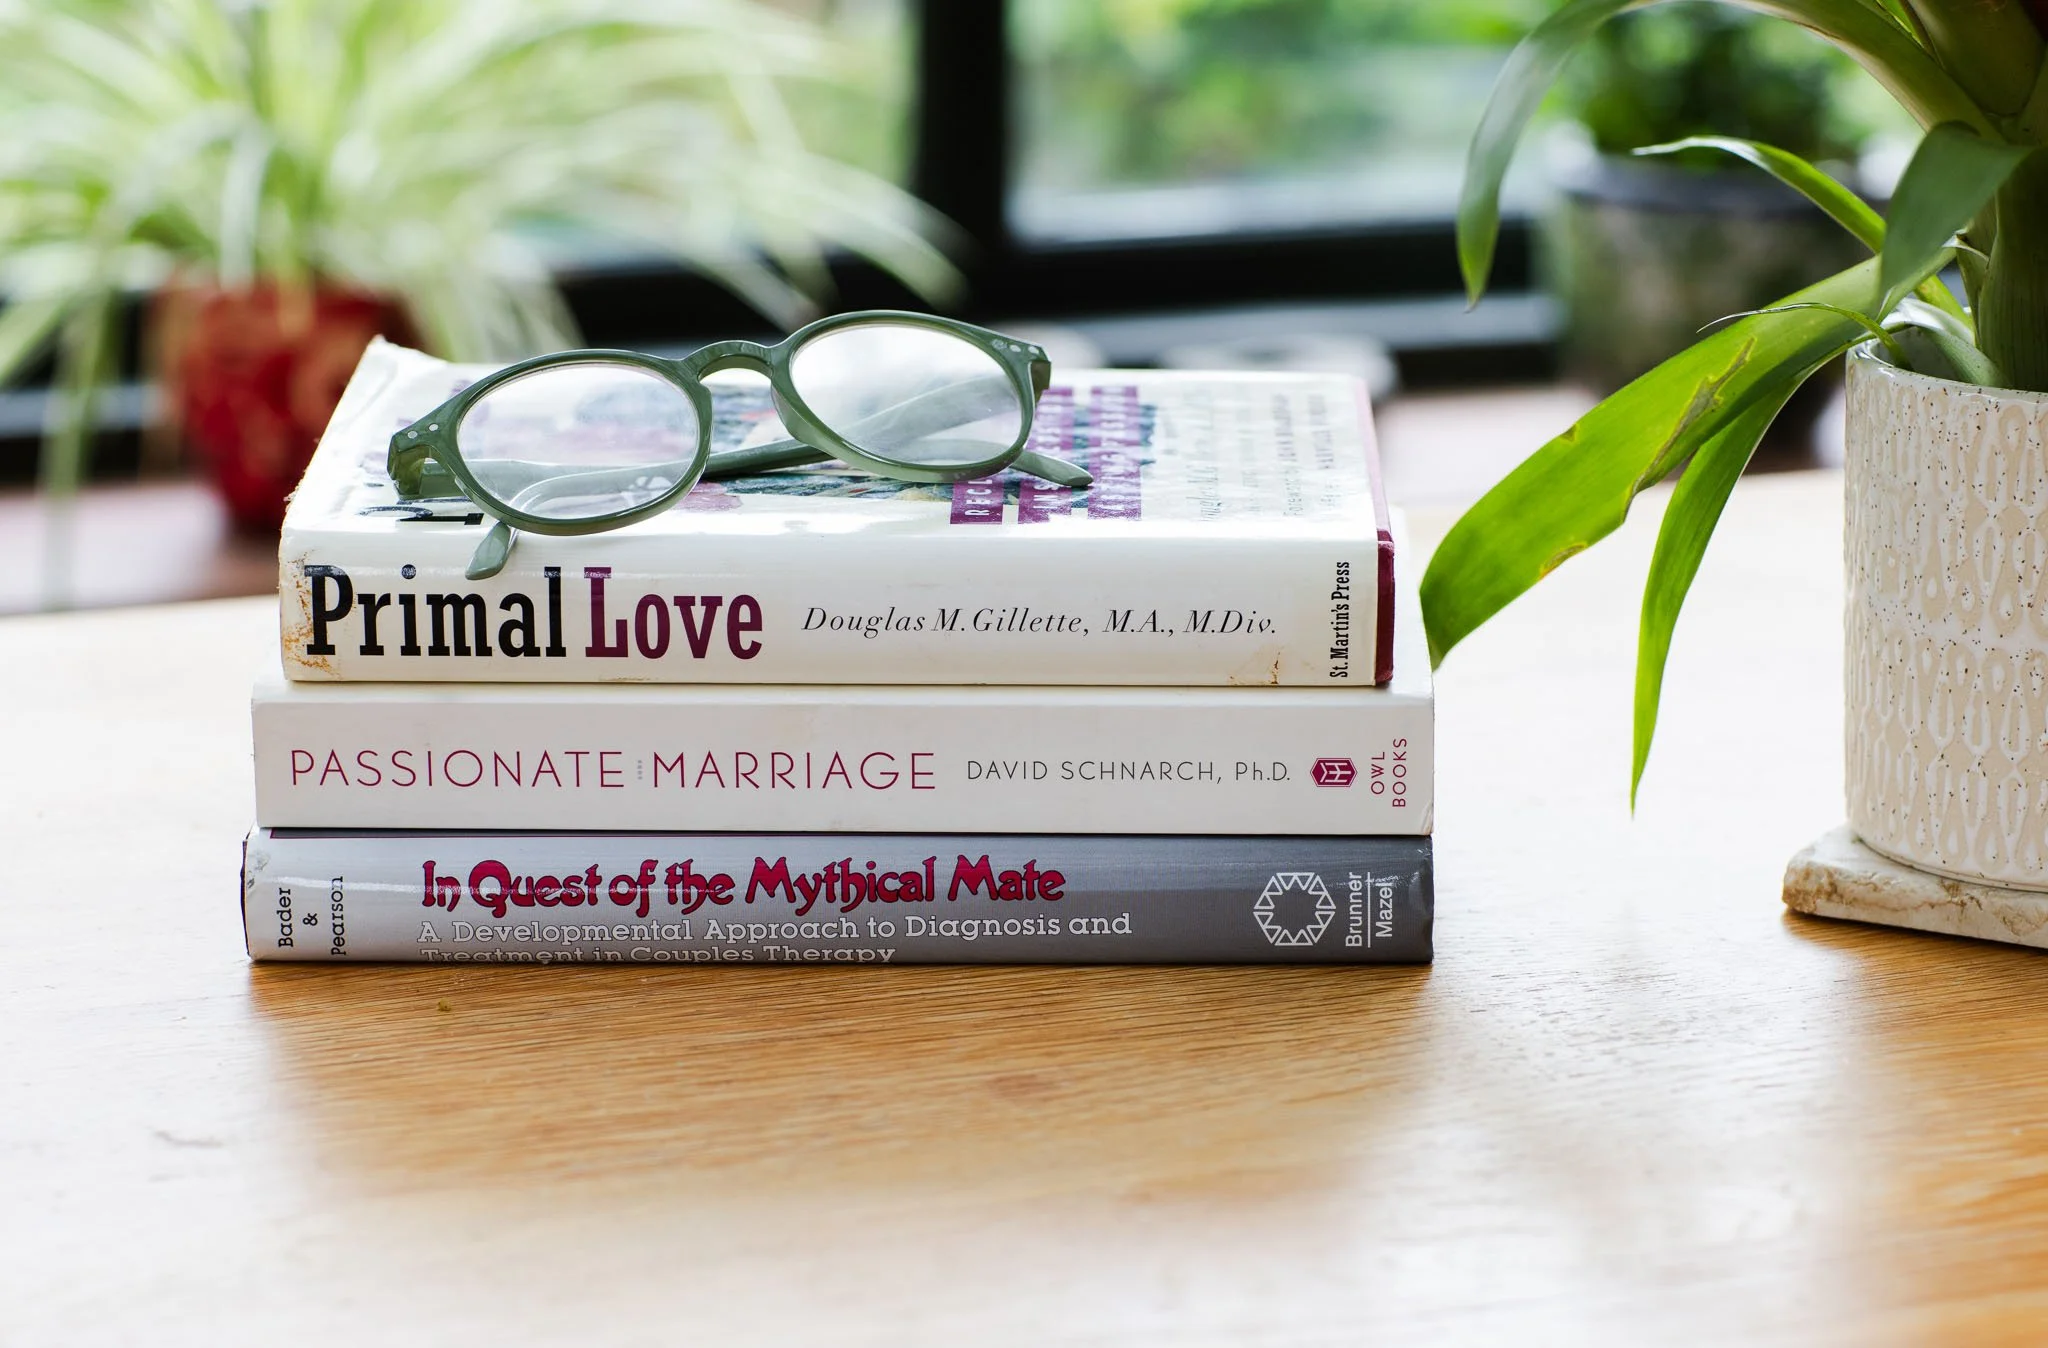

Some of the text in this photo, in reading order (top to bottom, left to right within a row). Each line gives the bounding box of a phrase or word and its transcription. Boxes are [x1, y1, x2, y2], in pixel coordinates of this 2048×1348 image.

[1098, 454, 1126, 512] ASTING
[304, 564, 763, 660] Primal Love
[801, 607, 1276, 639] Douglas M. Gillette, M.A., M.Div.
[1329, 561, 1350, 678] St. Martin's Press
[291, 749, 936, 790] PASSIONATE MARRIAGE
[967, 761, 1291, 785] DAVID SCHNARCH, Ph.D.
[1370, 751, 1386, 795] OWL
[1391, 738, 1408, 808] BOOKS
[422, 854, 1066, 918] In Quest of the Mythical Mate
[1345, 871, 1363, 947] Brunner
[1375, 879, 1393, 938] Mazel
[276, 887, 294, 948] Bader
[302, 912, 318, 926] &
[330, 876, 347, 956] Pearson
[417, 912, 1133, 946] A Developmental Approach to Diagnosis and
[420, 945, 896, 963] Treatment in Couples Therapy
